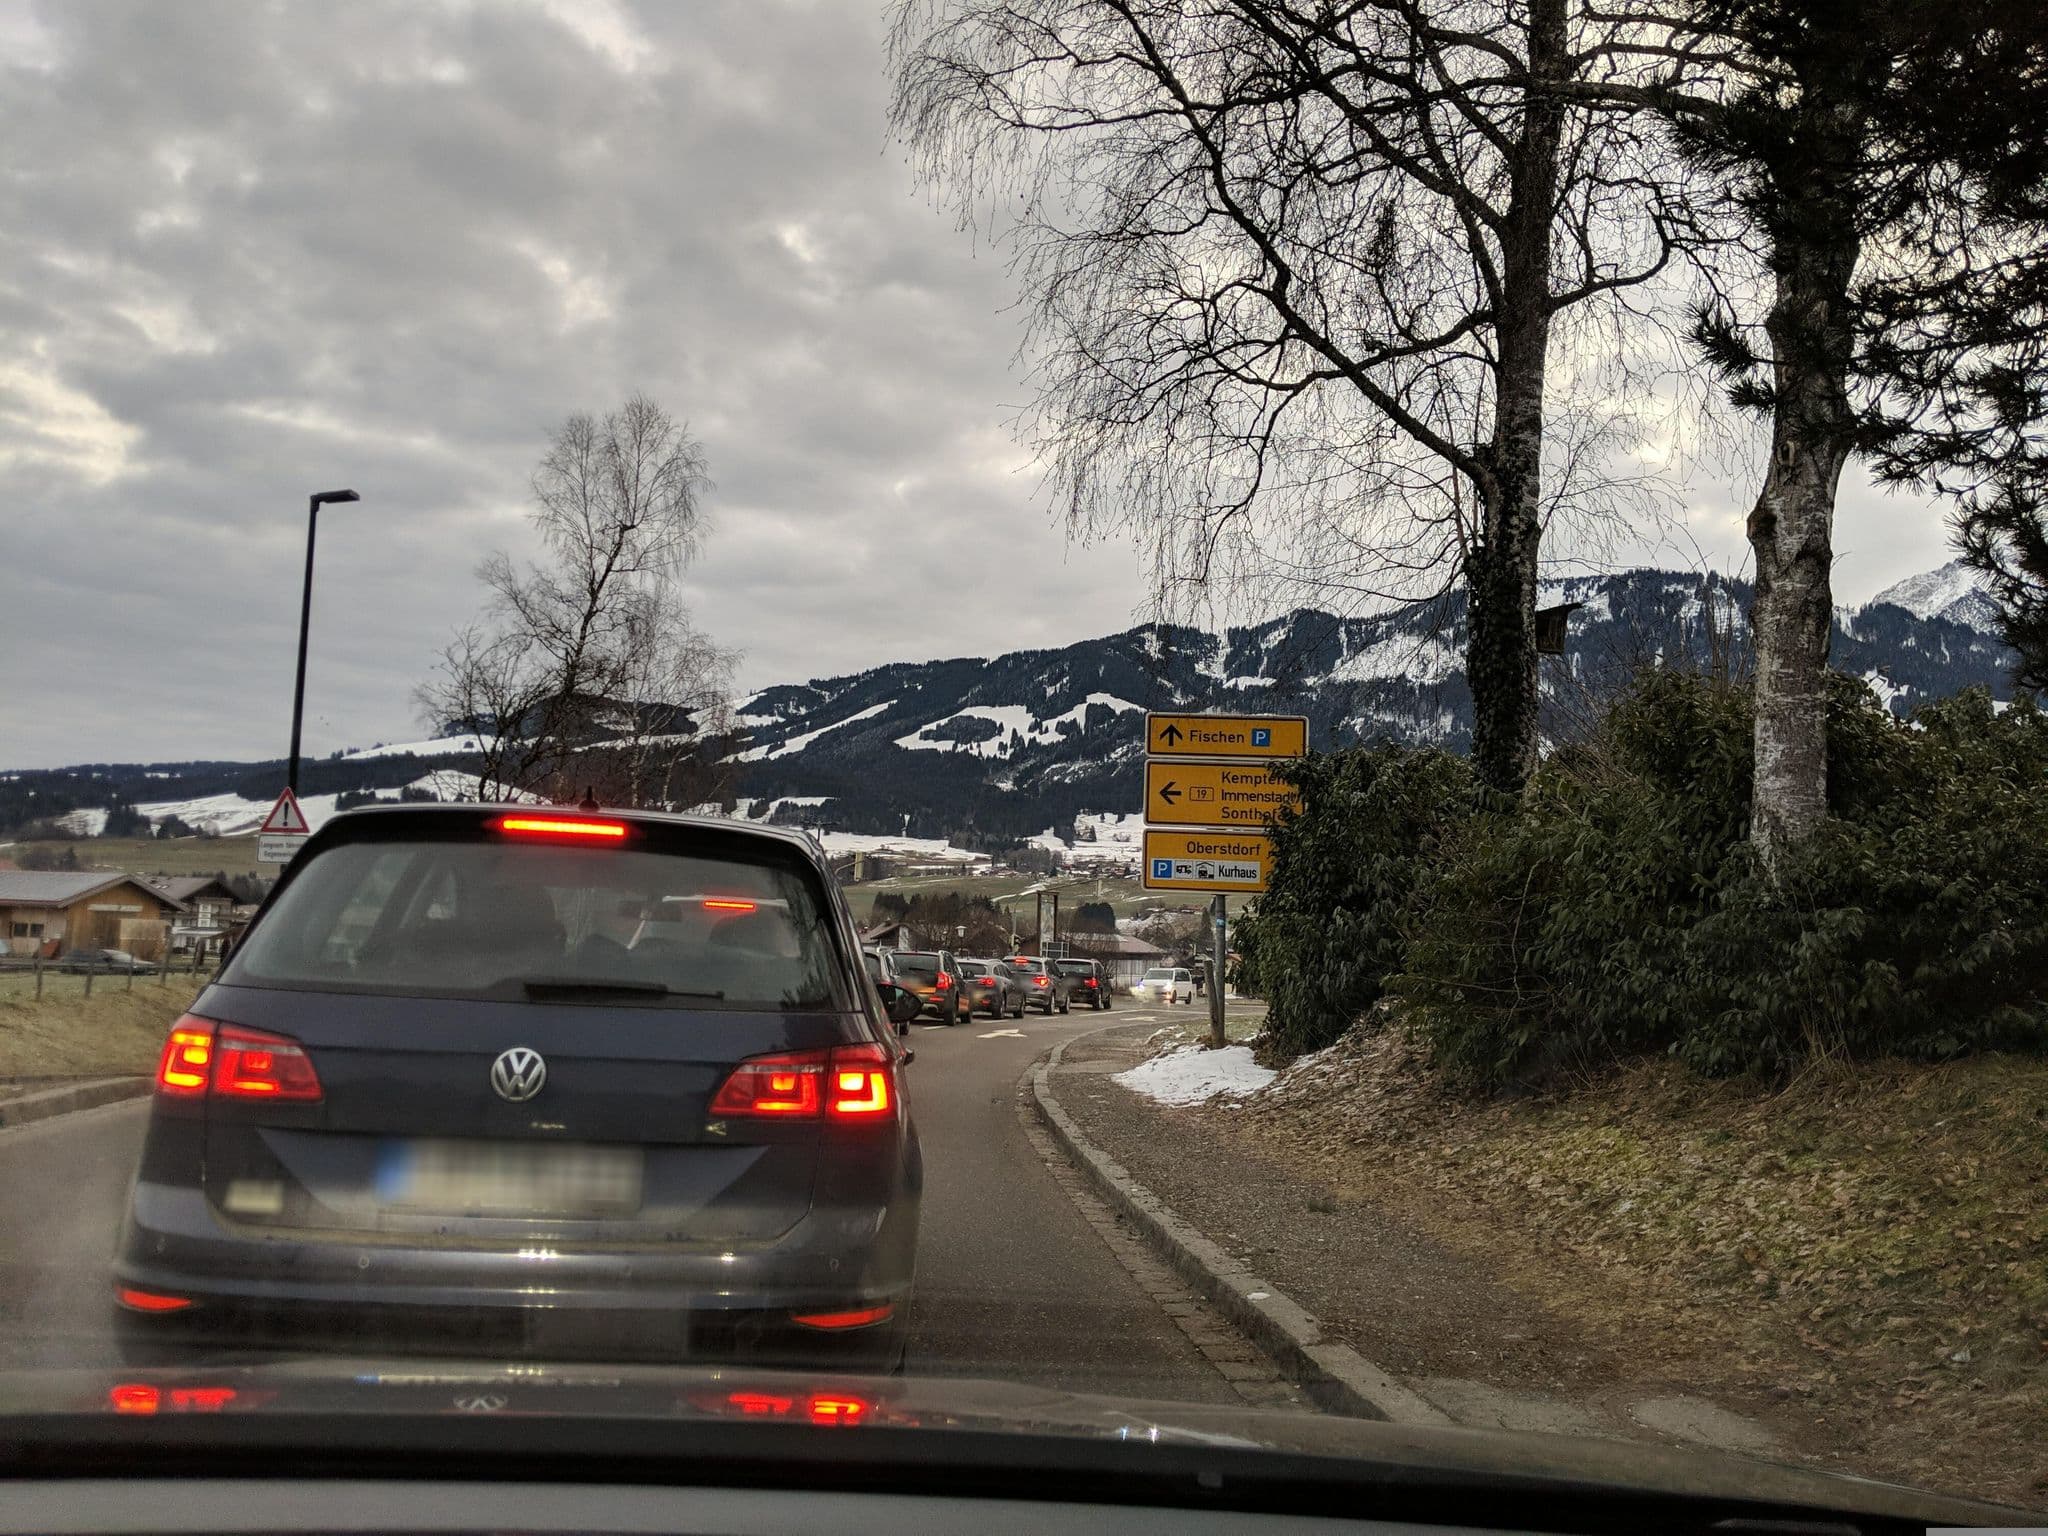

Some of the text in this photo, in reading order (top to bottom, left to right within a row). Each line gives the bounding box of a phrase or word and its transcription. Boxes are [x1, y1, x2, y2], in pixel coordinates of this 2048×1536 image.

[1190, 729, 1266, 745] Fischen P
[1197, 789, 1207, 799] 19
[1186, 841, 1262, 856] Oberstdorf
[1158, 862, 1257, 879] P Kurhaus
